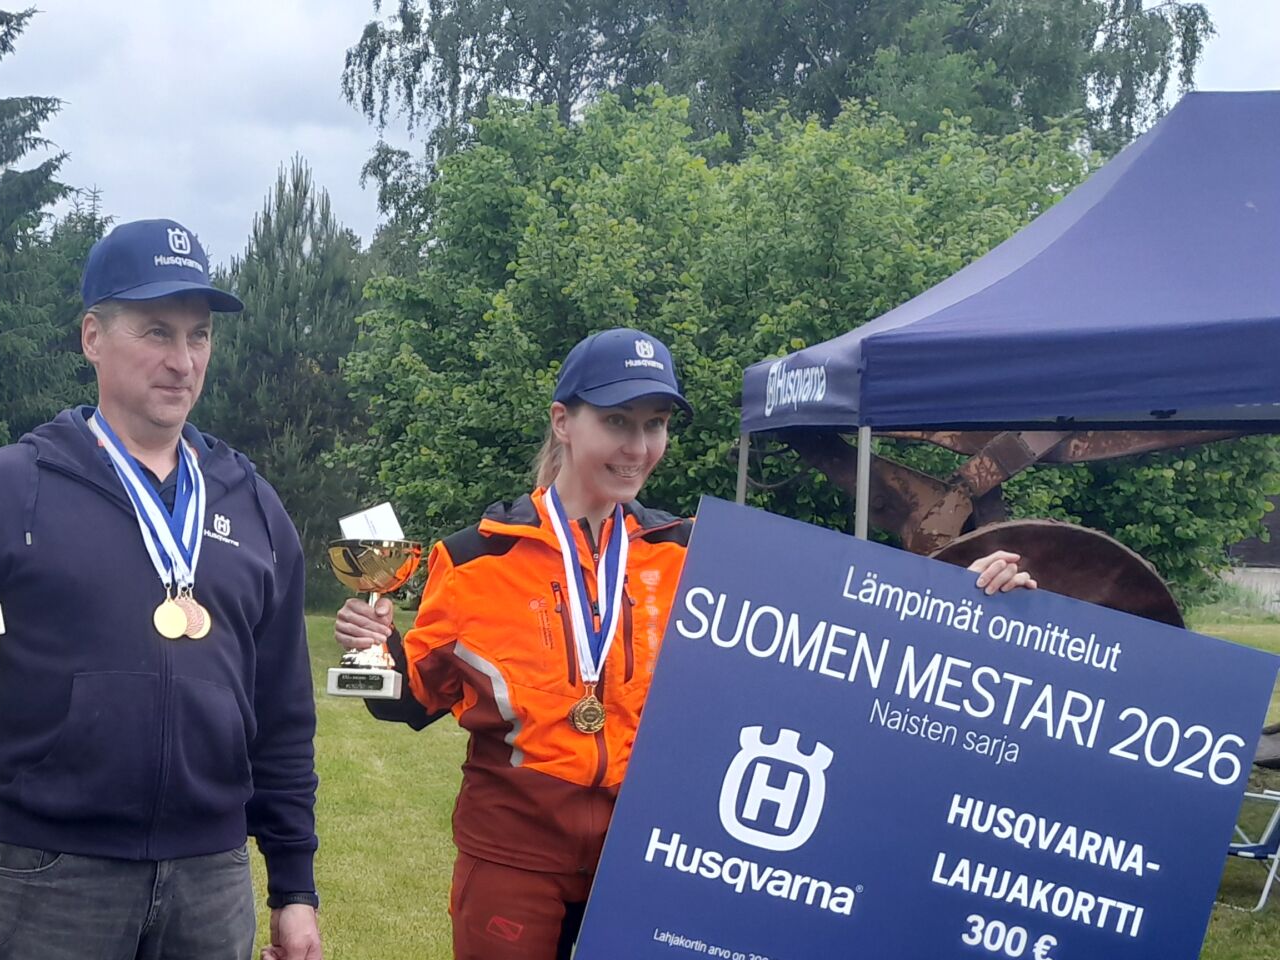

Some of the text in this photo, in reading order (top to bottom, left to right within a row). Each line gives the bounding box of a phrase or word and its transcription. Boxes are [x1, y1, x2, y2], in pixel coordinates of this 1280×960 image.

[154, 254, 204, 273] Husqvarna
[775, 363, 826, 412] Husqvarna
[842, 565, 1122, 673] Lämpimät onnittelut
[676, 587, 890, 689] SUOMEN
[894, 645, 1106, 749] MESTARI
[1108, 707, 1246, 786] 2026
[869, 698, 1020, 765] Naisten sarja
[947, 793, 1160, 877] HUSQVARNA-
[931, 852, 1144, 938] LAHJAKORTTI
[653, 928, 707, 953] Lahjakortin
[707, 945, 731, 959] arvo
[961, 914, 1028, 958] 300
